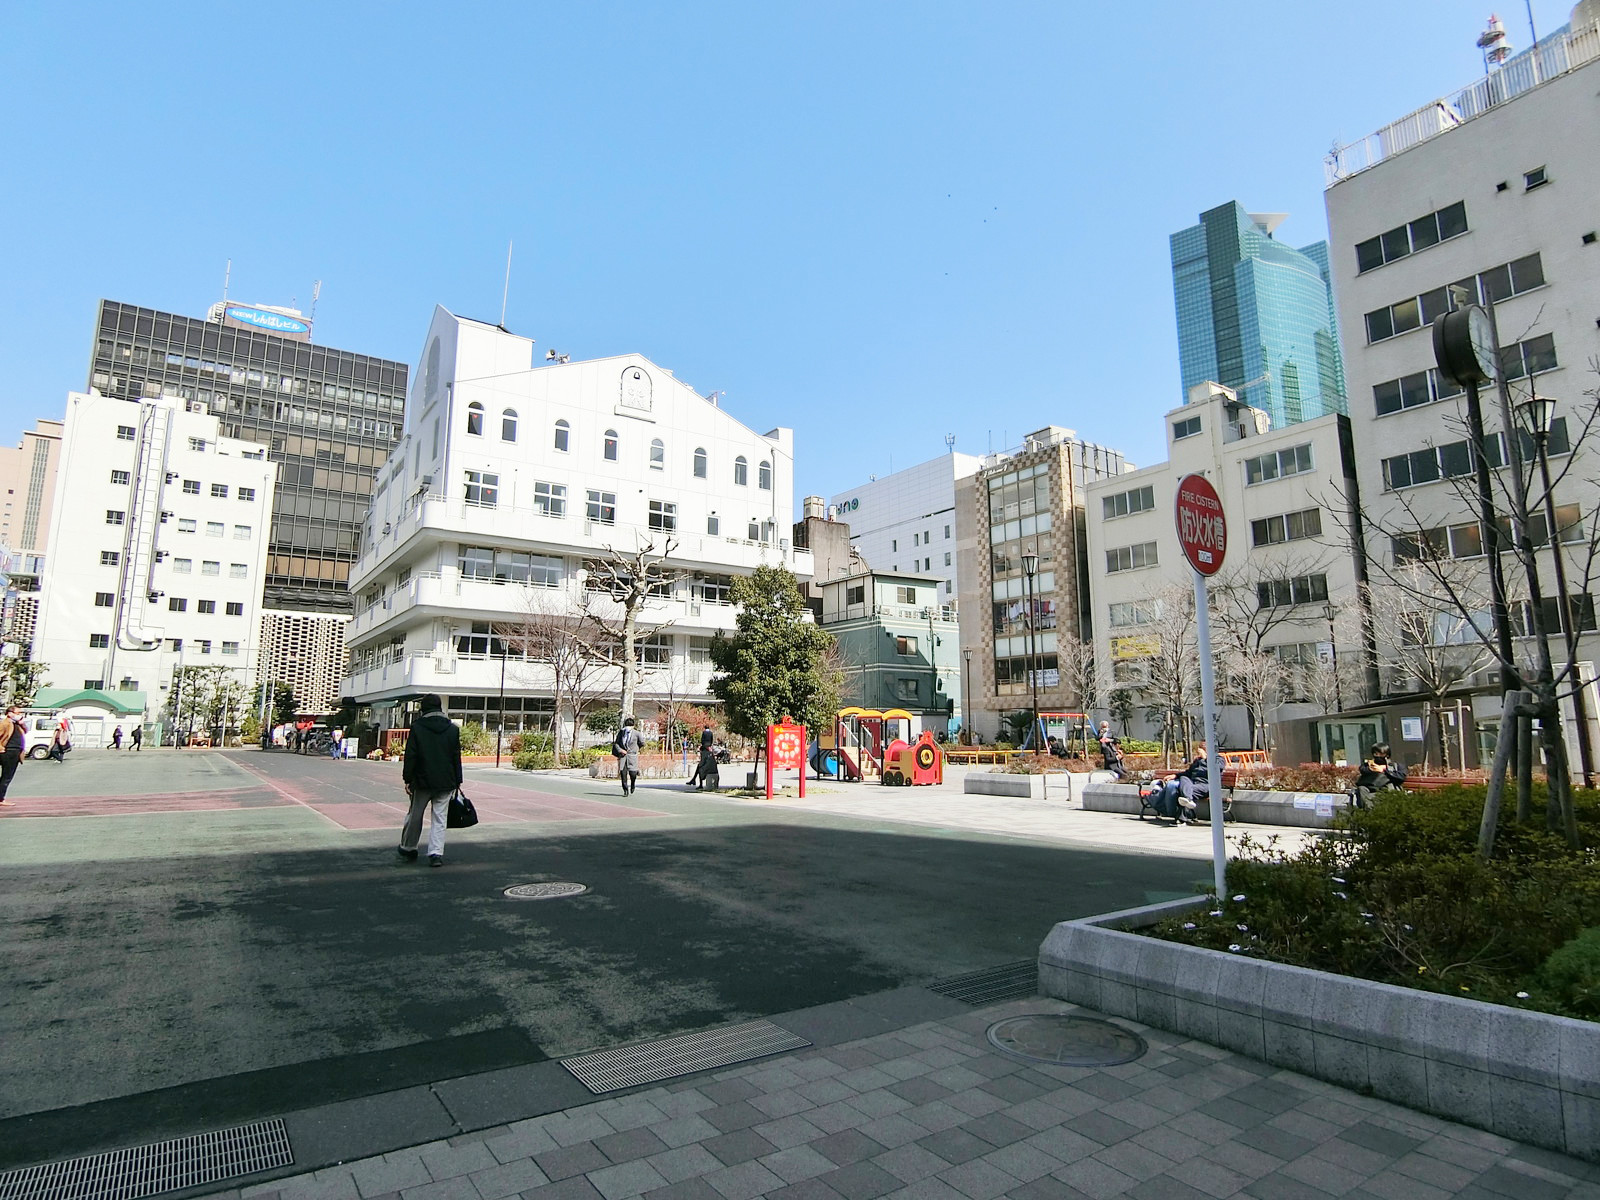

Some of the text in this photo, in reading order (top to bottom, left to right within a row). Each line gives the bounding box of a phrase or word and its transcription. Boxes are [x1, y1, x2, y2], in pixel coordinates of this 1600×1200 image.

[1181, 490, 1219, 511] FIRE CISTERN
[1180, 506, 1224, 551] 防火水槽
